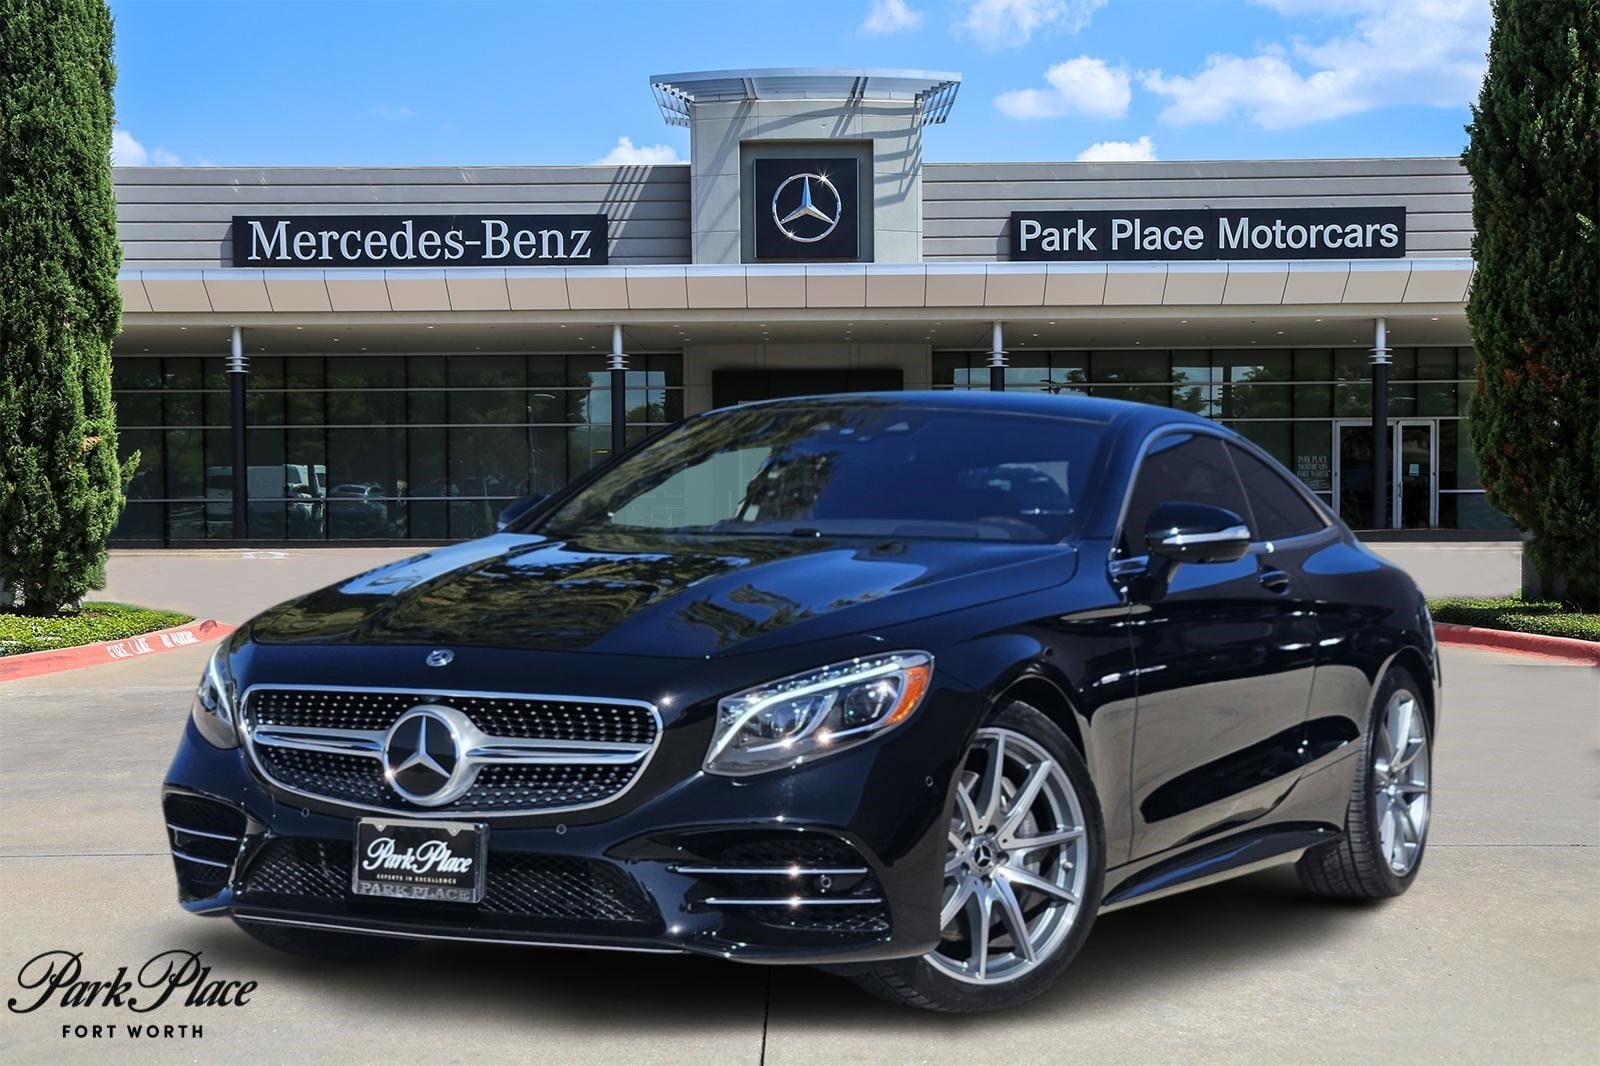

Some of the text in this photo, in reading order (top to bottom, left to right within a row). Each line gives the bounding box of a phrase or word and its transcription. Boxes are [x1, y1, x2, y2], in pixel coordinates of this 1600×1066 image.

[247, 219, 592, 261] Mercedes-Benz
[1019, 217, 1399, 252] Park Place Motorcars
[362, 837, 473, 873] Park Place
[360, 882, 471, 900] PARK PLACE
